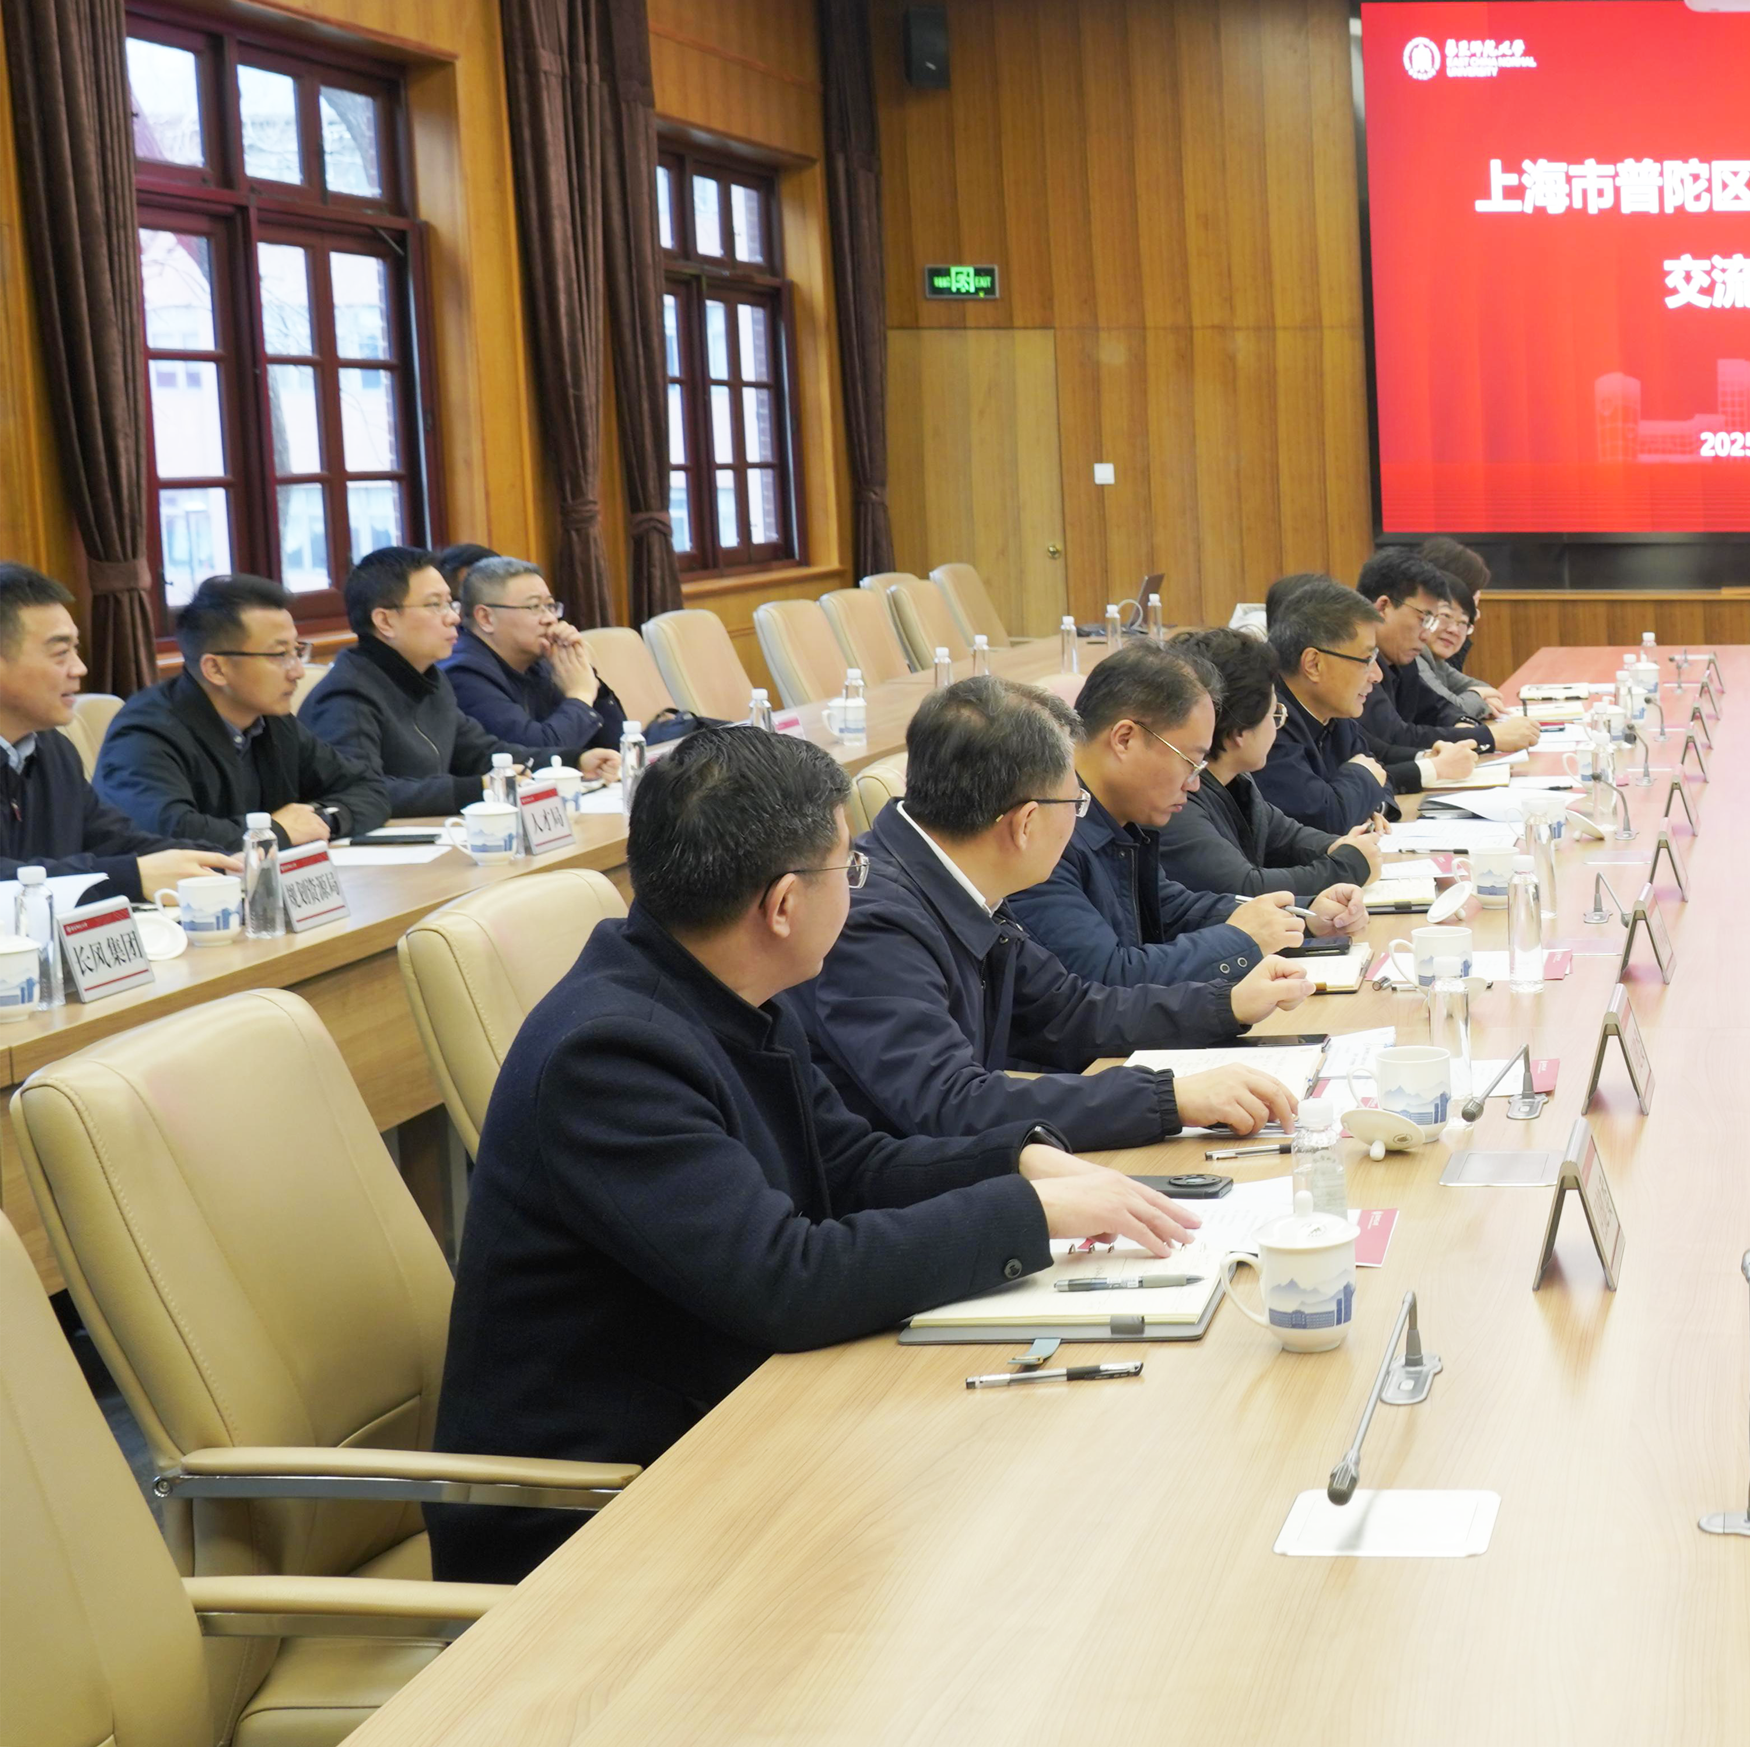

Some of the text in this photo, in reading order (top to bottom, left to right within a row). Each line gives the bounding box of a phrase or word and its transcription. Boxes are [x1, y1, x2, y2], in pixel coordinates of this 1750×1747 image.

[531, 806, 565, 835] 人才局
[73, 930, 143, 976] 长风集团
